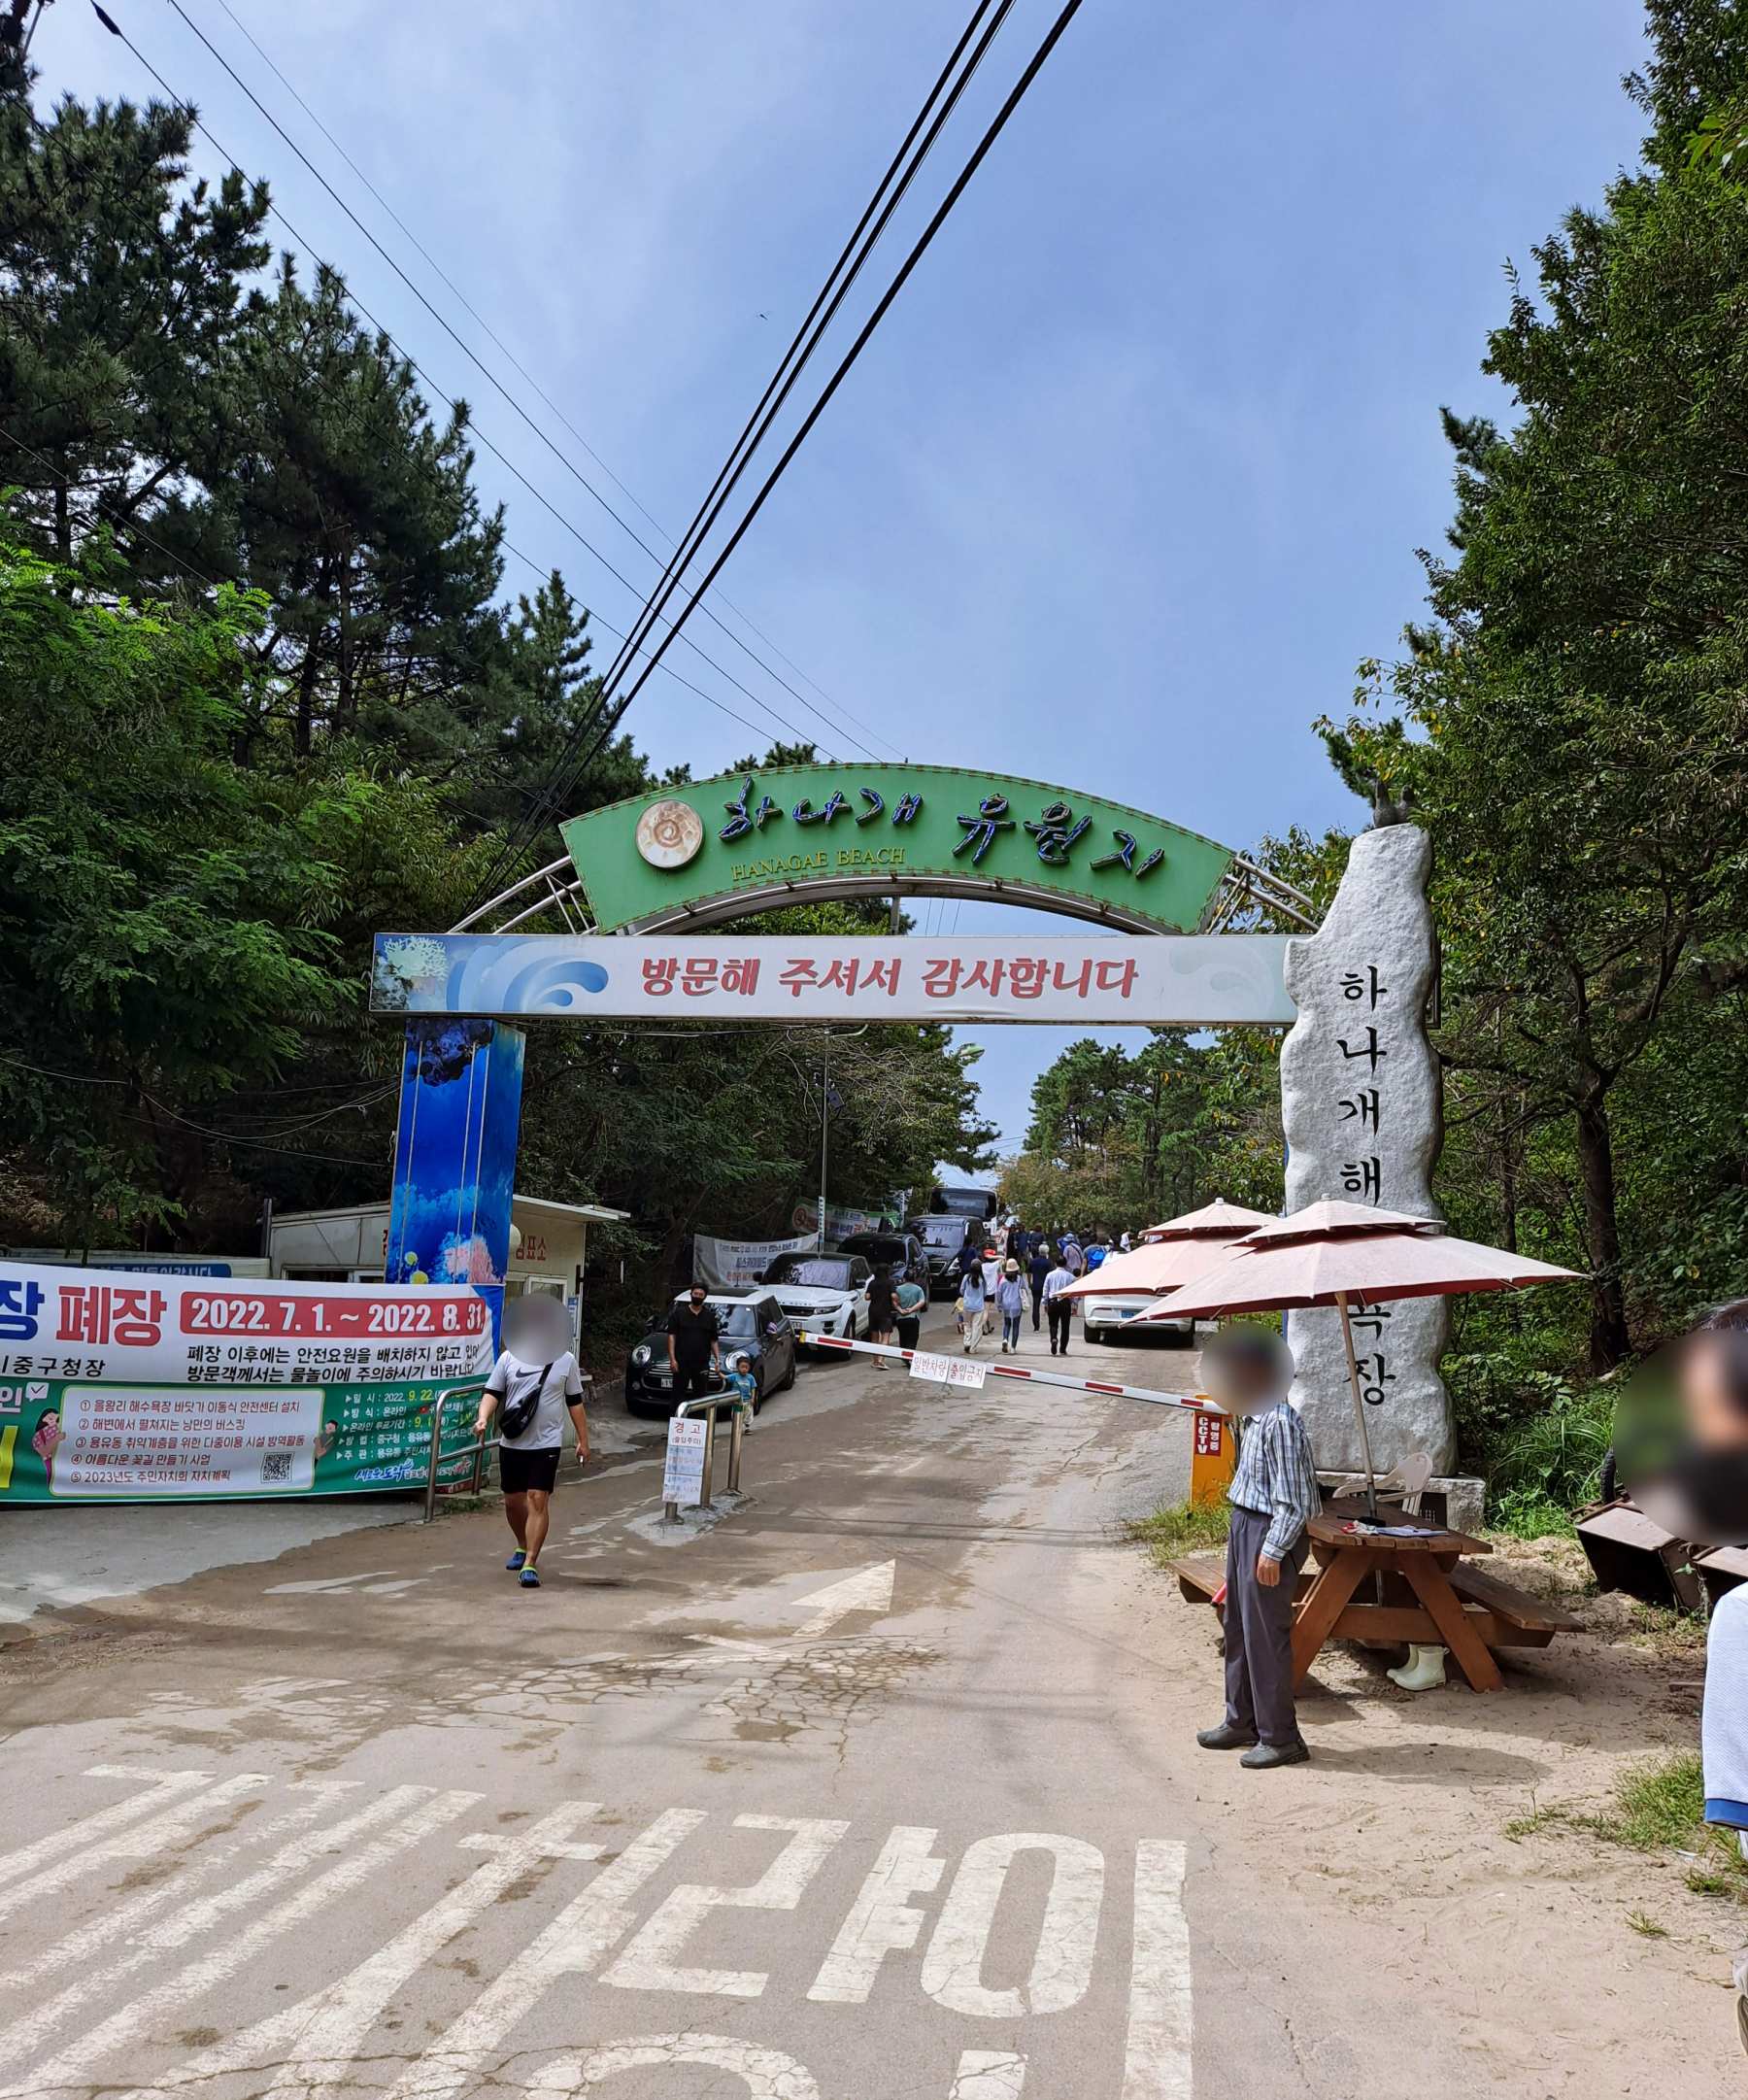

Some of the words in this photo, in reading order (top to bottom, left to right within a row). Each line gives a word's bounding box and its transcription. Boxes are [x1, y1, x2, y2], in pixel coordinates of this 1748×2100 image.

[719, 777, 924, 842] 하나개
[951, 792, 1163, 878] 유원지
[730, 850, 828, 881] HANAGAE
[836, 846, 905, 866] BEACH
[641, 957, 760, 997] 방문해
[778, 957, 902, 998] 주셔서
[921, 957, 1140, 999] 감사합니다
[55, 1285, 167, 1346] 폐장
[190, 1298, 270, 1330] 2022.
[279, 1303, 301, 1331] 7.
[312, 1304, 332, 1331] 1.
[368, 1304, 435, 1332] 2022.
[442, 1304, 460, 1331] 8.
[466, 1304, 484, 1330] 31.
[187, 1346, 220, 1364] 폐장
[228, 1346, 290, 1364] 이후에는
[297, 1346, 371, 1364] 안전요원을
[377, 1346, 431, 1362] 배치하지
[436, 1345, 461, 1361] 않고
[186, 1366, 285, 1382] 방문객께서는
[290, 1366, 351, 1382] 물놀이에
[356, 1365, 424, 1381] 주의하시기
[913, 1356, 947, 1377] 일반차량
[950, 1362, 985, 1383] 출입금지
[129, 1400, 171, 1413] 해수욕장
[175, 1400, 204, 1413] 바닷가
[208, 1402, 237, 1413] 이동식
[240, 1402, 278, 1413] 안전센터
[282, 1402, 300, 1413] 설치
[92, 1418, 135, 1431] 해변에서
[183, 1419, 213, 1431] 낭만의
[217, 1419, 245, 1431] 버스킹
[126, 1438, 177, 1449] 취약계층을
[181, 1438, 201, 1448] 위한
[204, 1437, 243, 1448] 다중이용
[246, 1437, 265, 1447] 시설
[85, 1454, 129, 1466] 아름다운
[155, 1455, 187, 1466] 만들기
[189, 1454, 211, 1465] 사업
[84, 1472, 133, 1483] 2023년도
[137, 1471, 187, 1482] 주민자치회
[191, 1470, 230, 1481] 자치계획
